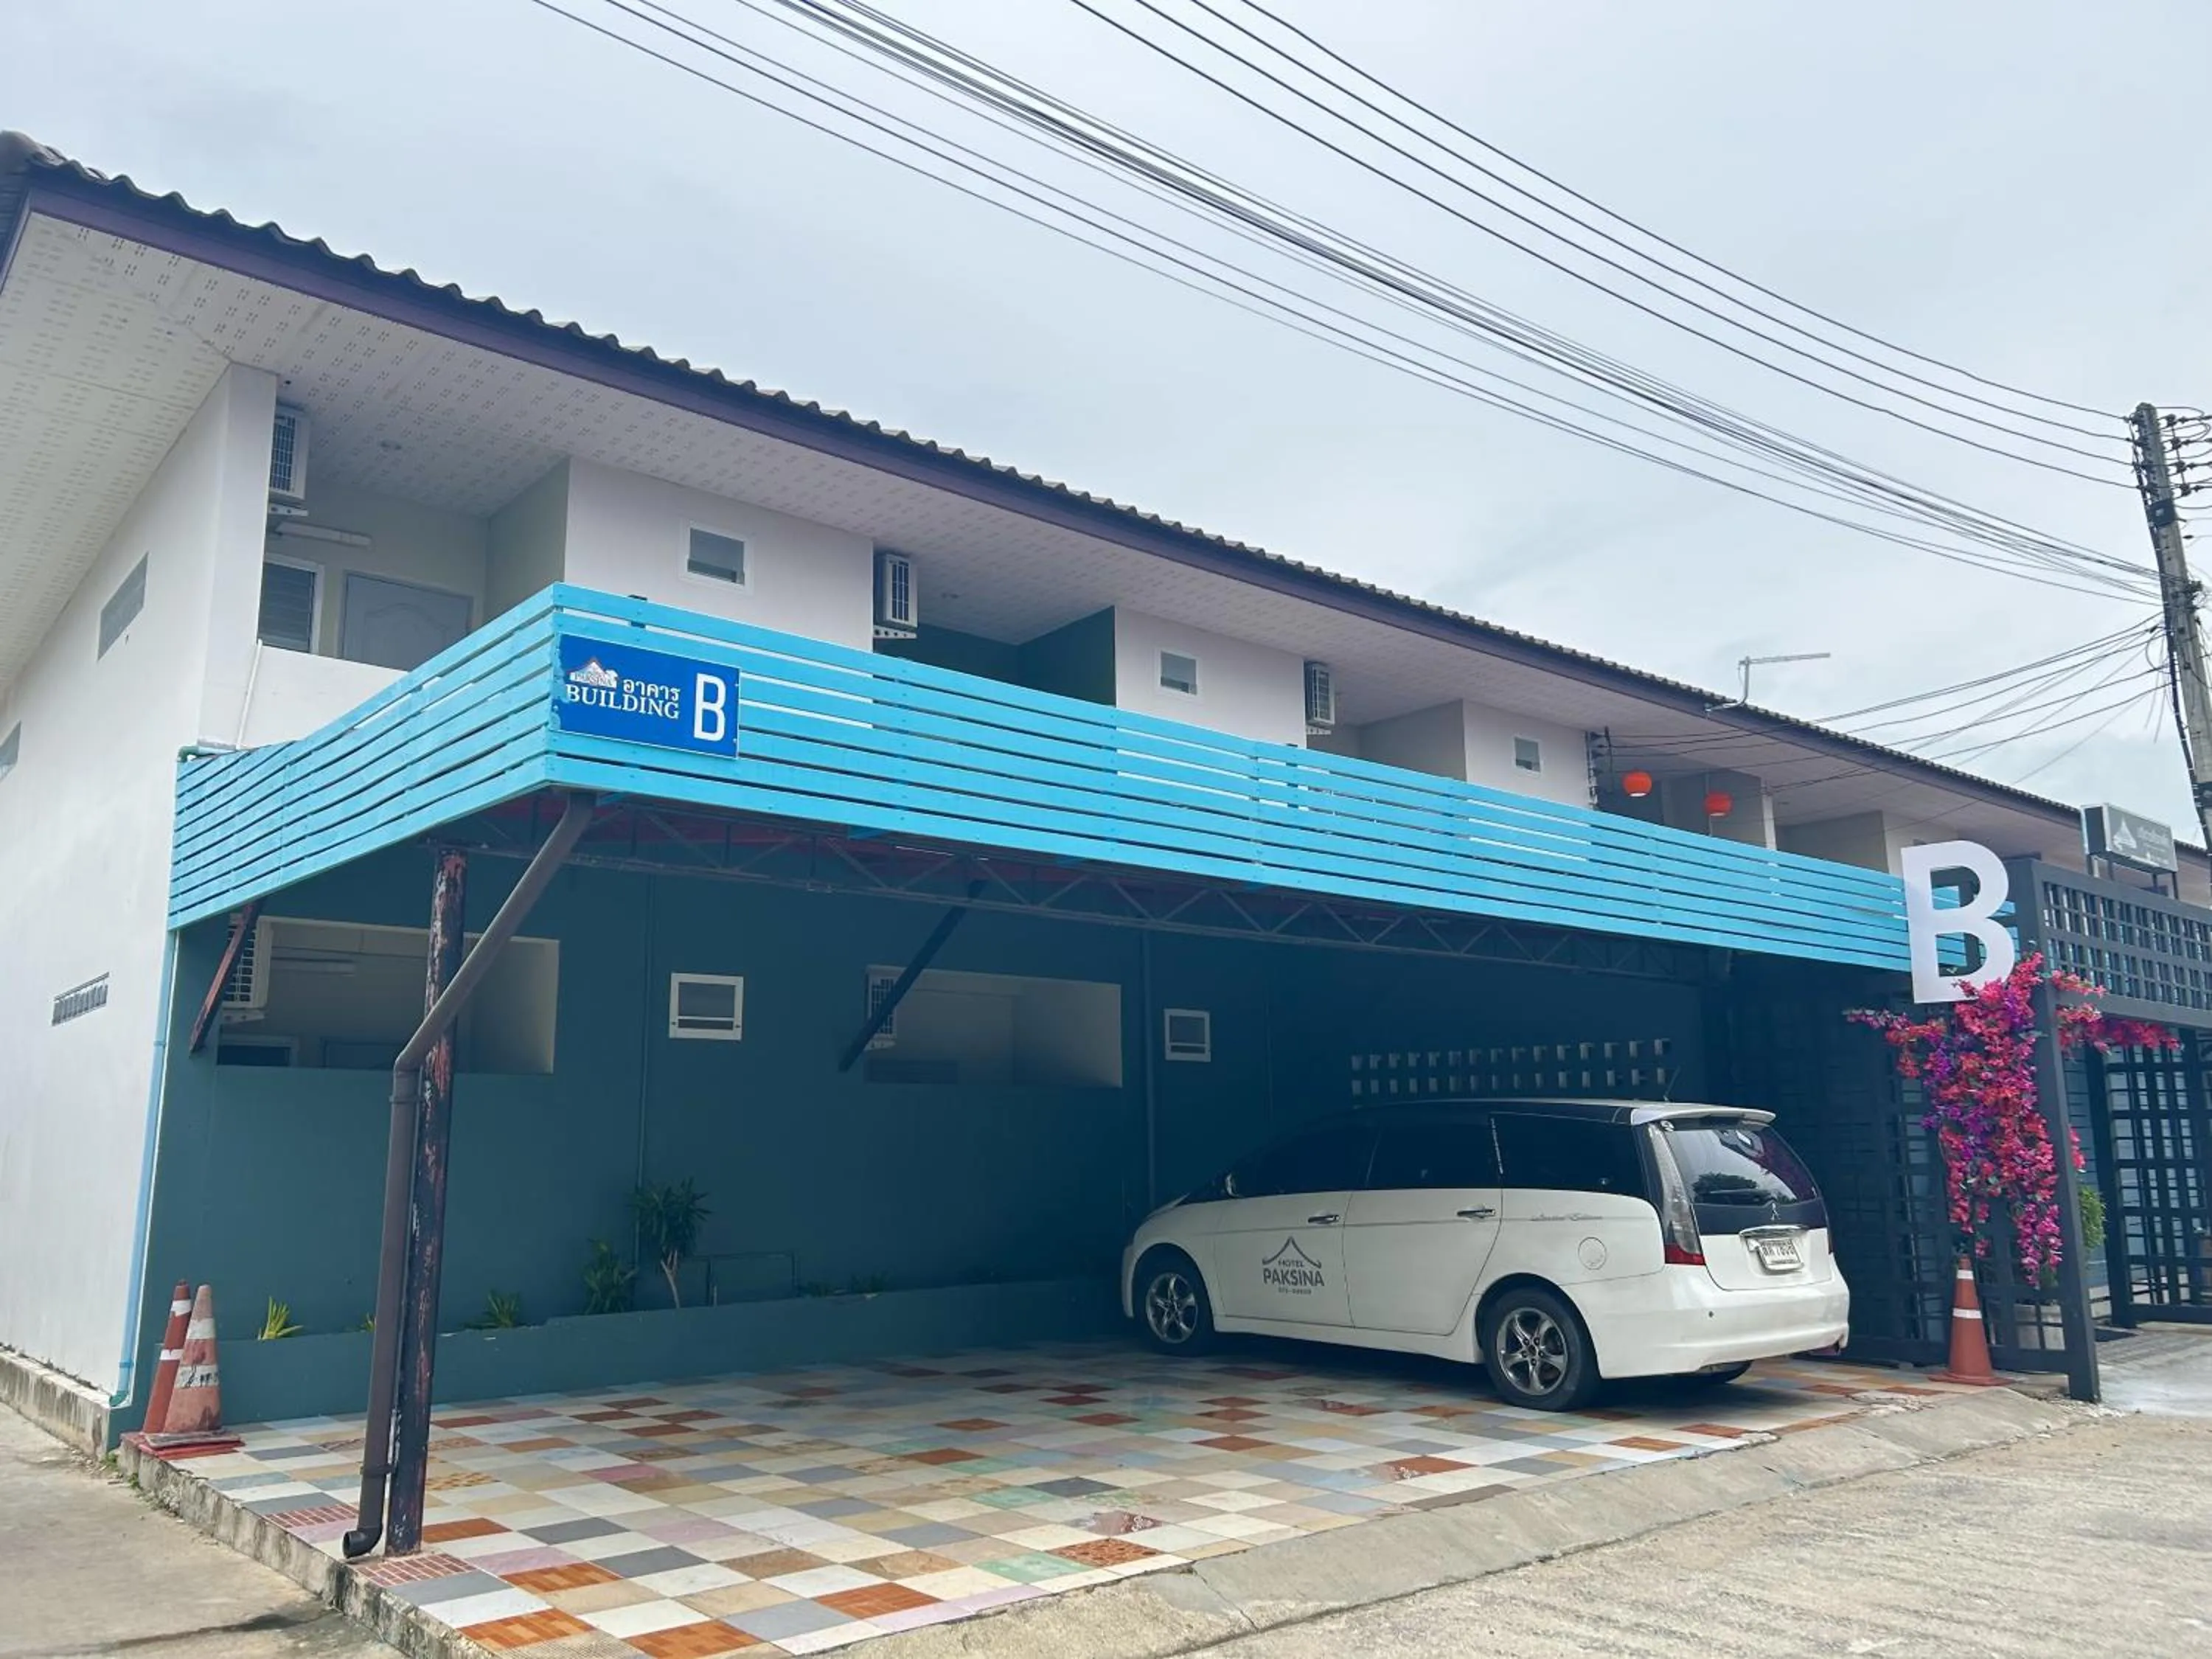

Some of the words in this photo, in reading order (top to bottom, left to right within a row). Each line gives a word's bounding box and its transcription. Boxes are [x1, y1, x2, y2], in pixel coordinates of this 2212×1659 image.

[566, 684, 681, 720] BUILDING
[623, 678, 681, 701] อาคาร
[693, 672, 726, 742] B
[1901, 840, 2015, 1004] B
[1262, 1267, 1325, 1287] PAKSINA
